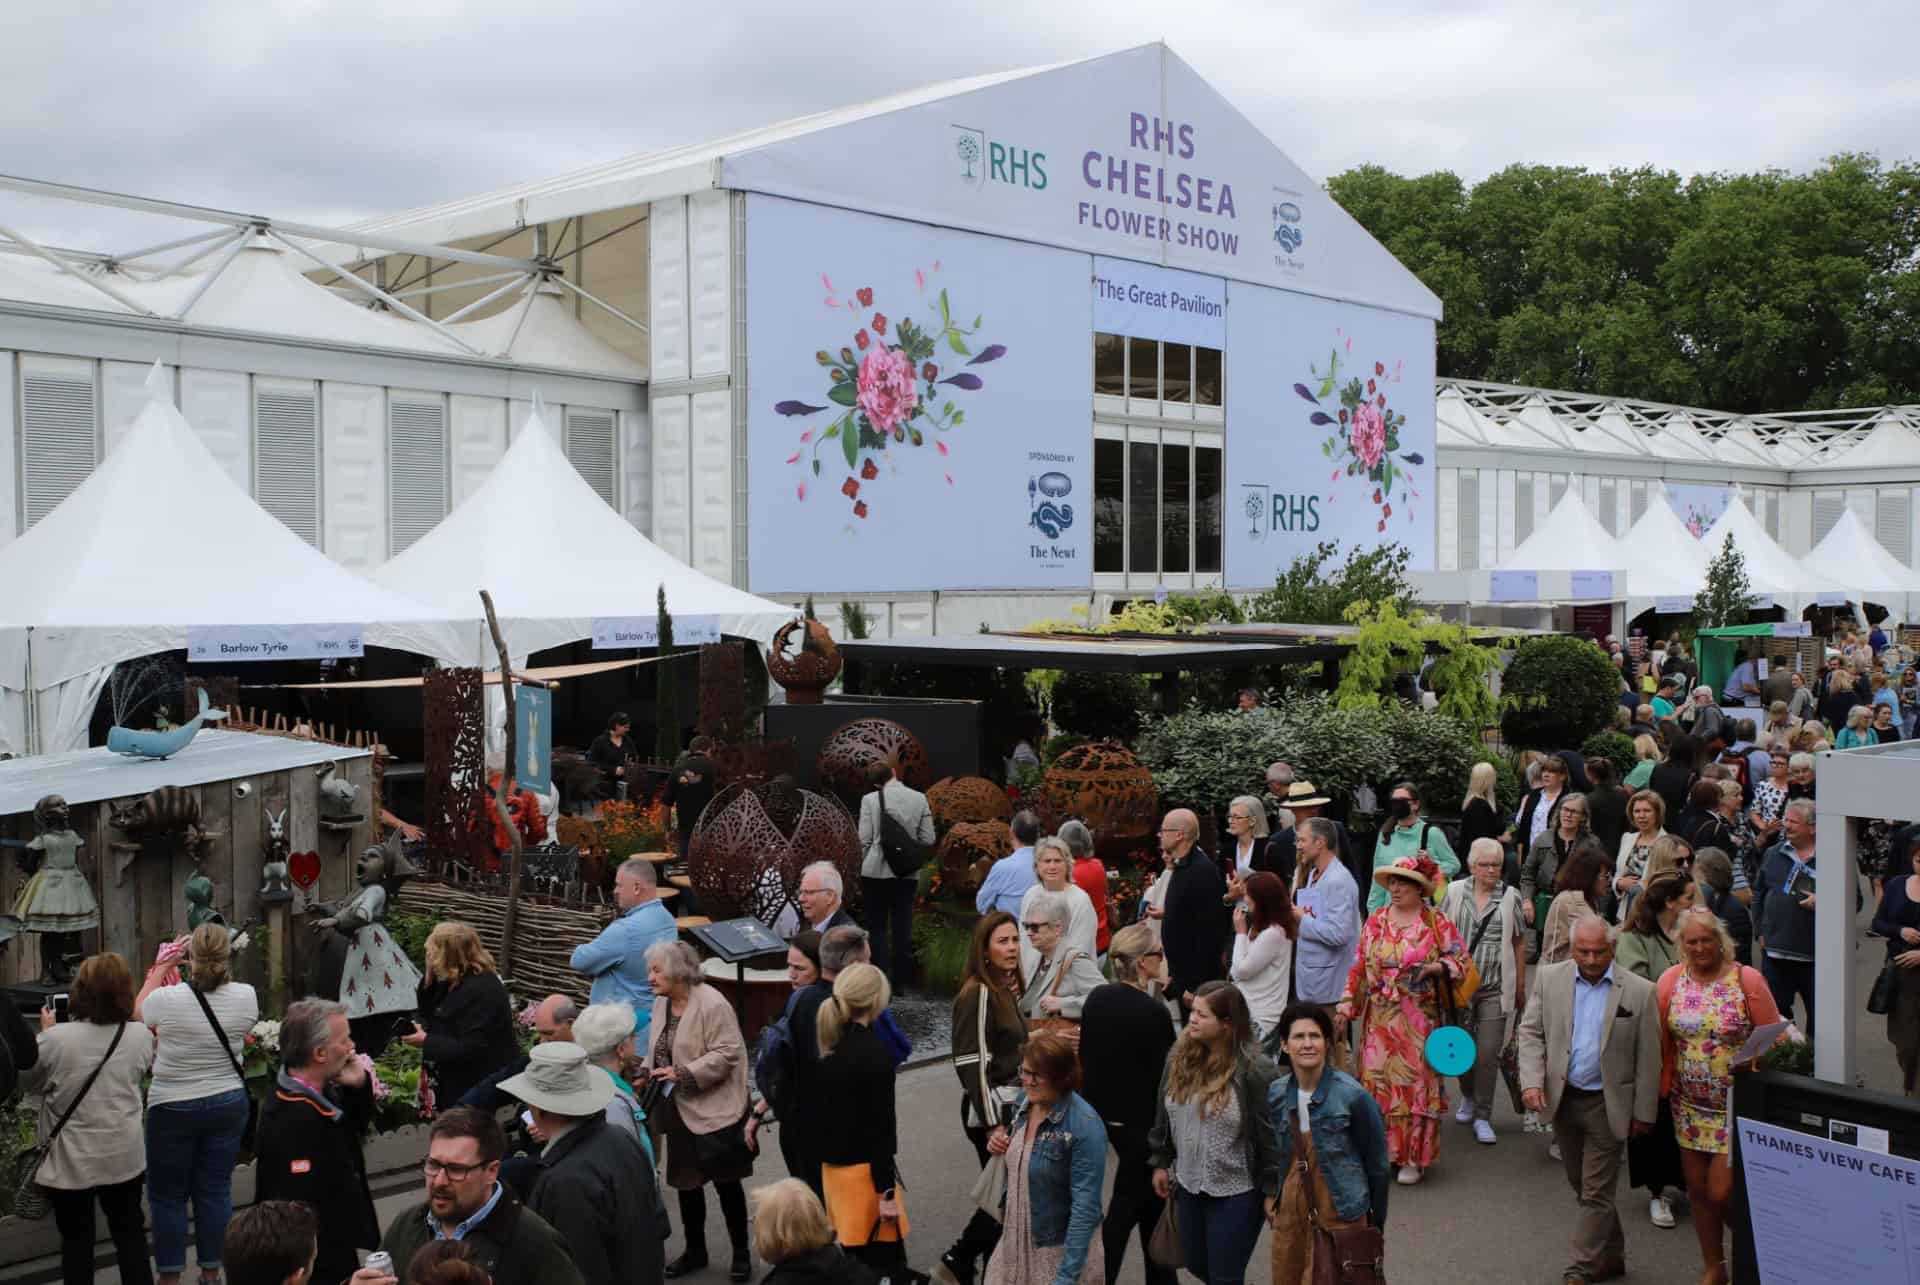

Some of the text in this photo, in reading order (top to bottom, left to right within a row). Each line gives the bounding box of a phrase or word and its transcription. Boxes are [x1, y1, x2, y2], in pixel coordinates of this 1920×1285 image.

[1130, 112, 1195, 159] RHS
[989, 141, 1048, 190] RHS
[1082, 151, 1236, 219] CHELSEA
[1078, 202, 1239, 255] FLOWER SHOW
[1098, 278, 1222, 318] The Great Pavilion
[1272, 493, 1320, 532] RHS
[1030, 544, 1076, 559] The Newt
[220, 642, 259, 655] Barlow
[261, 642, 289, 655] Tyrie
[614, 631, 643, 641] Barlow
[1745, 1130, 1815, 1160] THAMES
[1818, 1149, 1864, 1172] VIEW
[1869, 1162, 1917, 1185] CAFE
